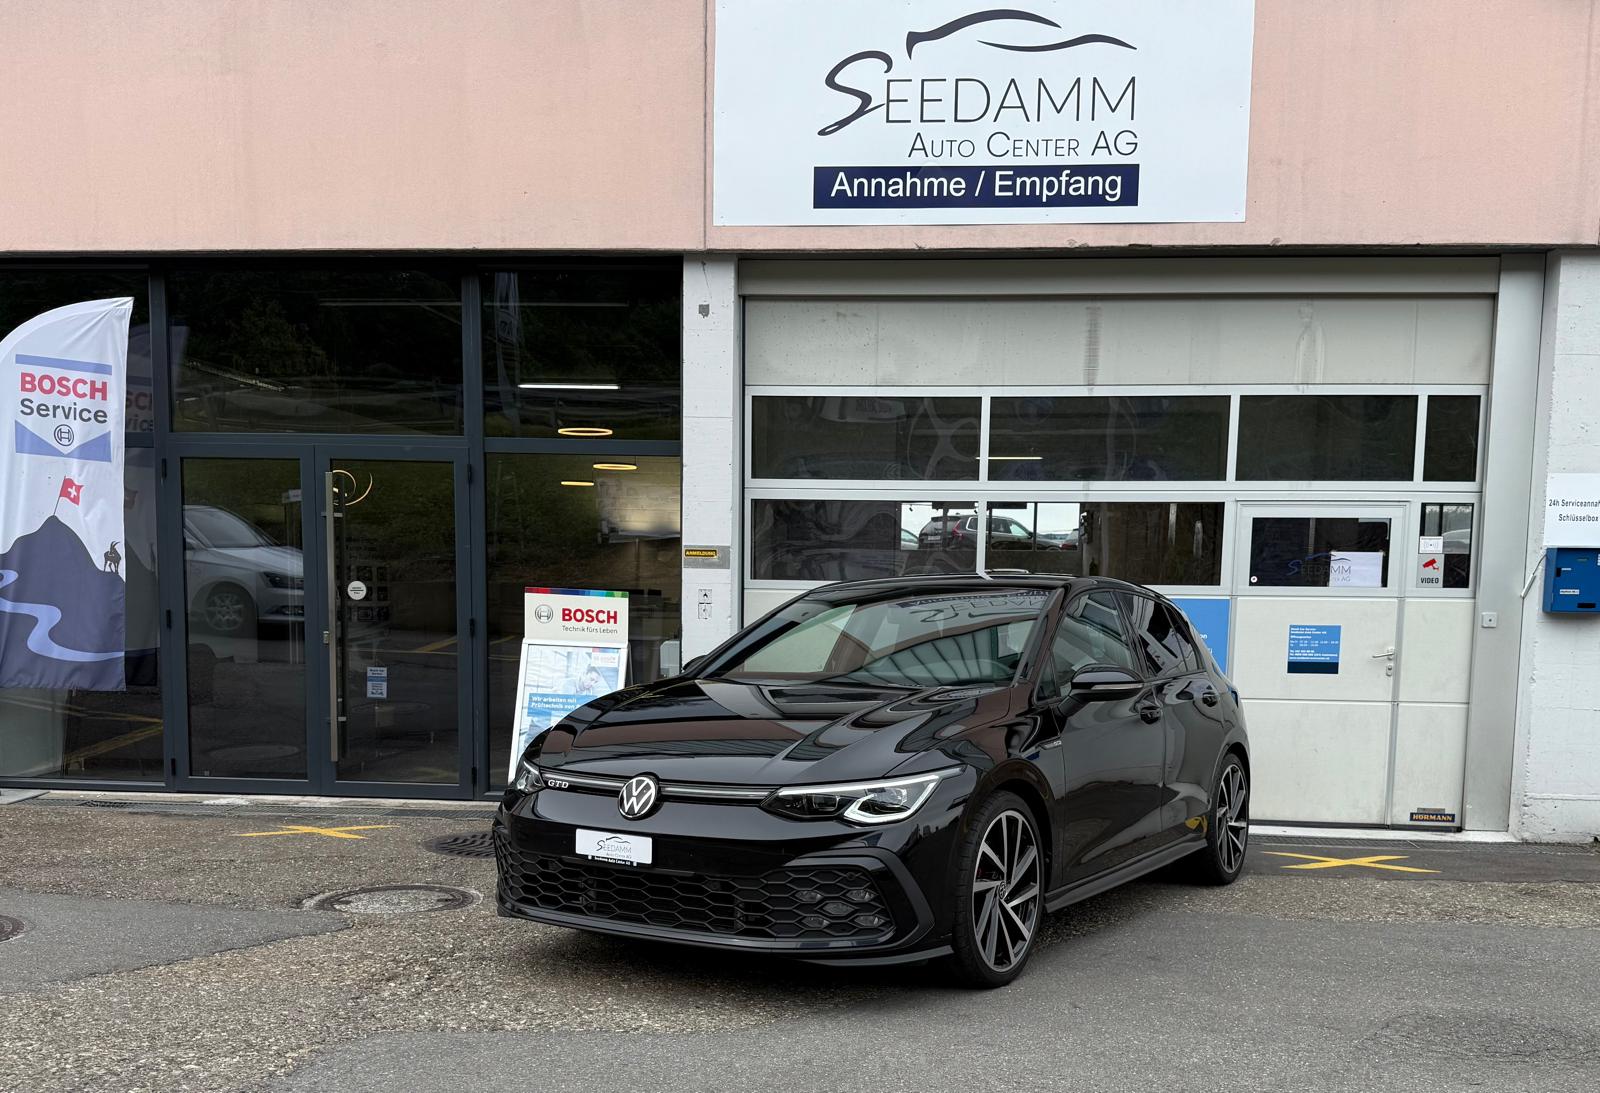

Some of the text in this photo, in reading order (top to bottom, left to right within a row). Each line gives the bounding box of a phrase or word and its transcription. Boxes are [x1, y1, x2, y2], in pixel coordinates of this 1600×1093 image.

[817, 50, 1137, 137] SEEDAMM
[908, 129, 1138, 158] AUTO CENTER AG
[831, 171, 967, 198] Annahme
[994, 170, 1123, 203] Empfang
[20, 372, 107, 401] BOSCH
[20, 398, 108, 424] Service
[1558, 513, 1599, 522] Schlüsselbox
[561, 608, 618, 624] BOSCH
[562, 625, 585, 633] Technik
[599, 626, 618, 634] Leben
[548, 779, 569, 788] GTD
